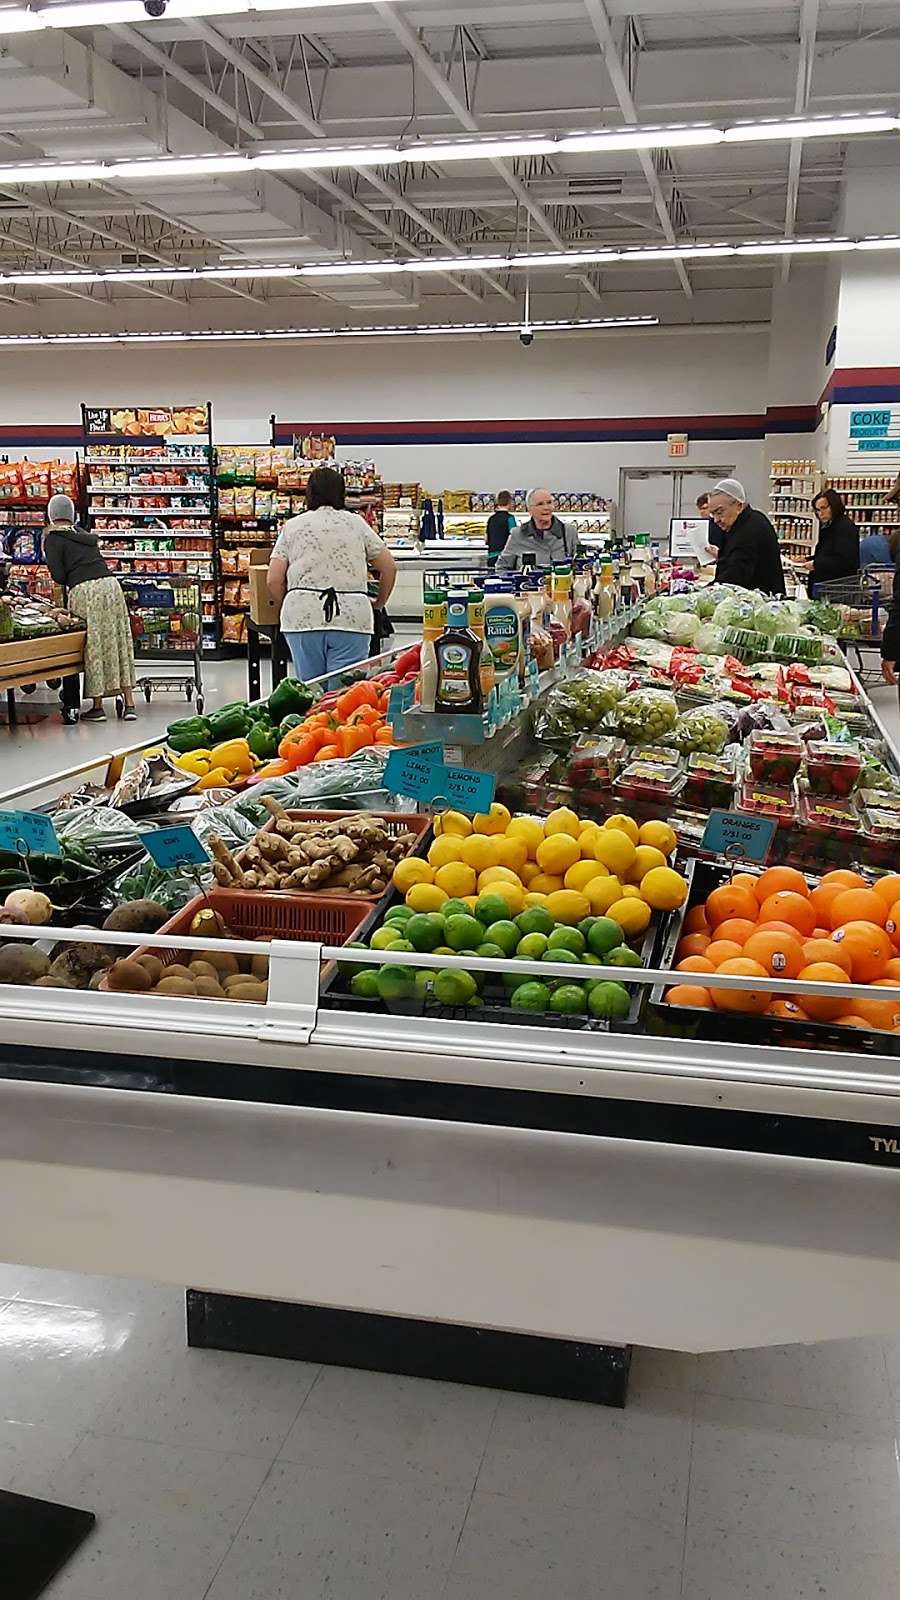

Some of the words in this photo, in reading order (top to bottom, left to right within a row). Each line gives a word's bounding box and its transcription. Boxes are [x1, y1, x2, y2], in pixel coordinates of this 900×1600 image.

[853, 412, 889, 425] COKE
[671, 444, 684, 454] EXIT
[487, 624, 515, 636] Ranch
[406, 760, 432, 774] LIMES
[447, 771, 481, 784] LEMONS
[721, 817, 761, 831] ORANGES
